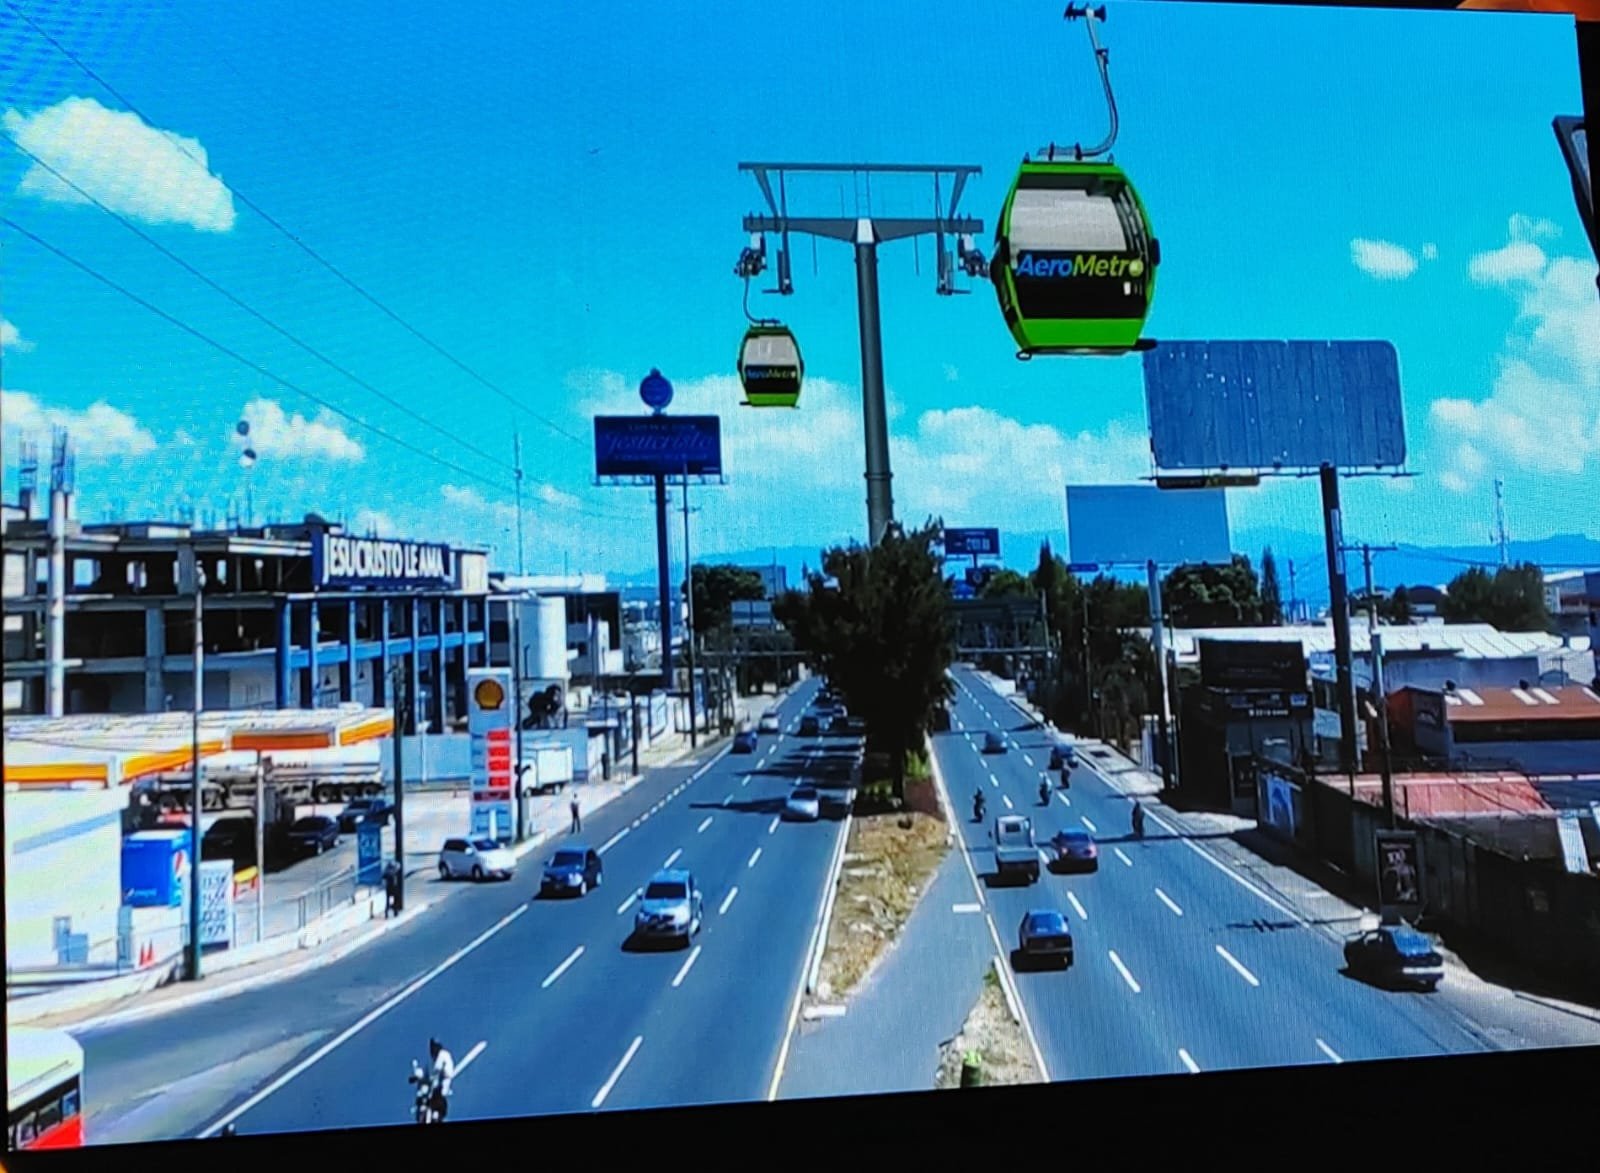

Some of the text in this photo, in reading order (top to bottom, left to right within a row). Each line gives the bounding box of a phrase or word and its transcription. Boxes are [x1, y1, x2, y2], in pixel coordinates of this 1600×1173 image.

[1016, 254, 1144, 277] AeroMetro
[322, 533, 404, 584] JESUCRISTO
[404, 544, 419, 578] LE
